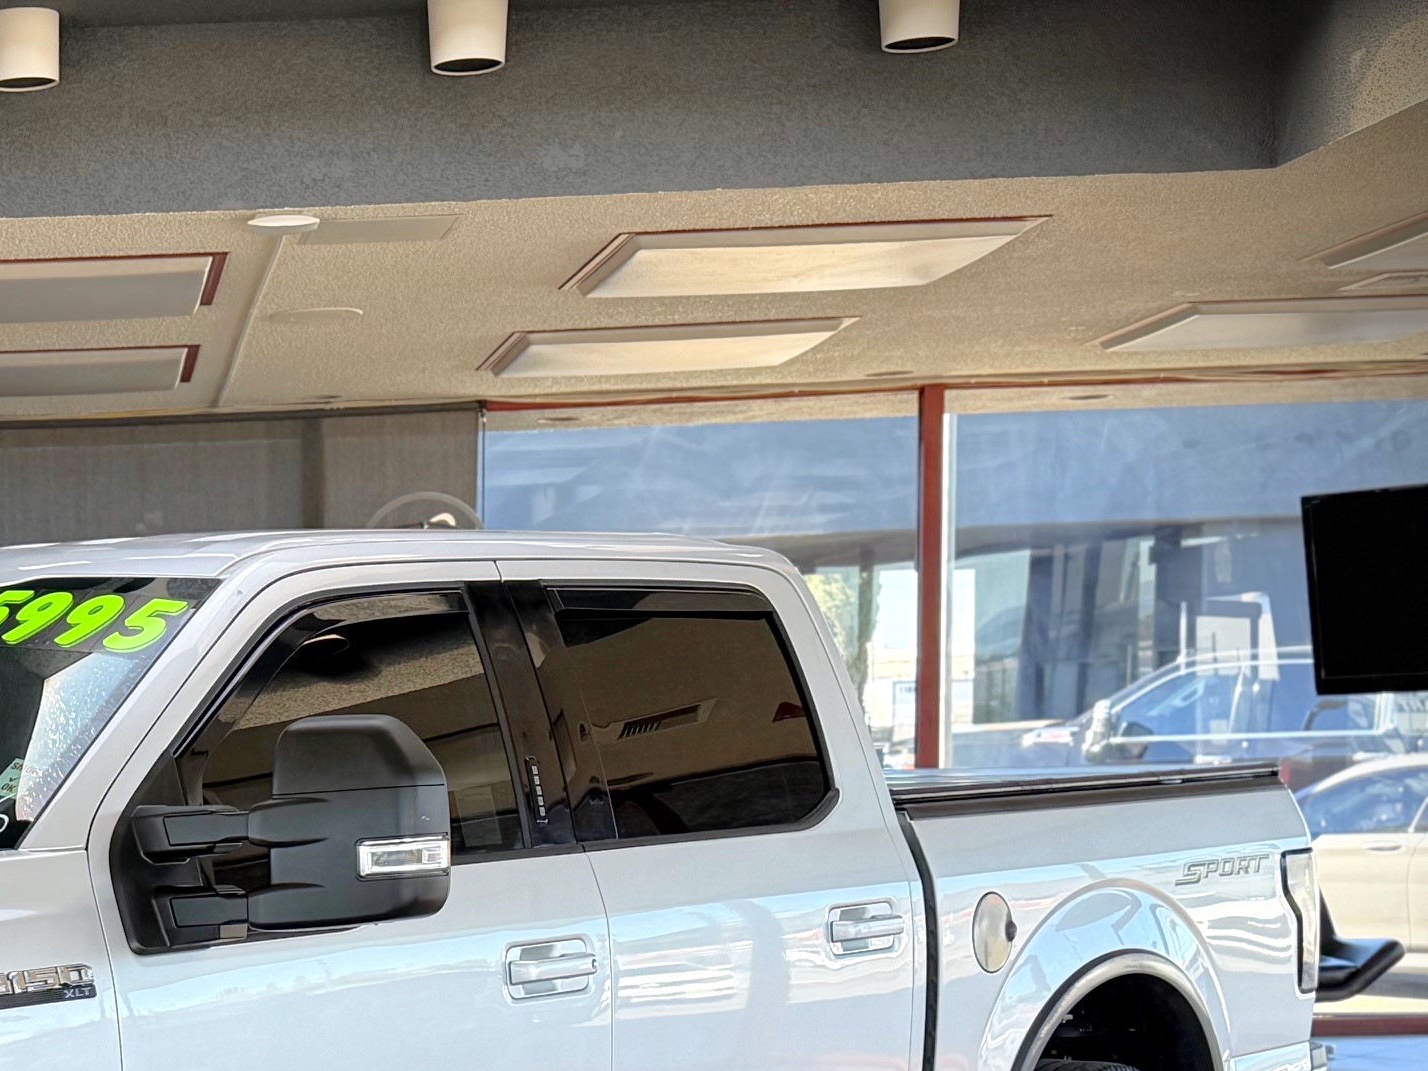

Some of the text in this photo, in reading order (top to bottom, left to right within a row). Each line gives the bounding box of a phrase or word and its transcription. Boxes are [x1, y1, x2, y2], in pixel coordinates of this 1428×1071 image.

[1, 782, 16, 792] OK
[1175, 854, 1269, 886] SPORT
[63, 987, 92, 998] XLT
